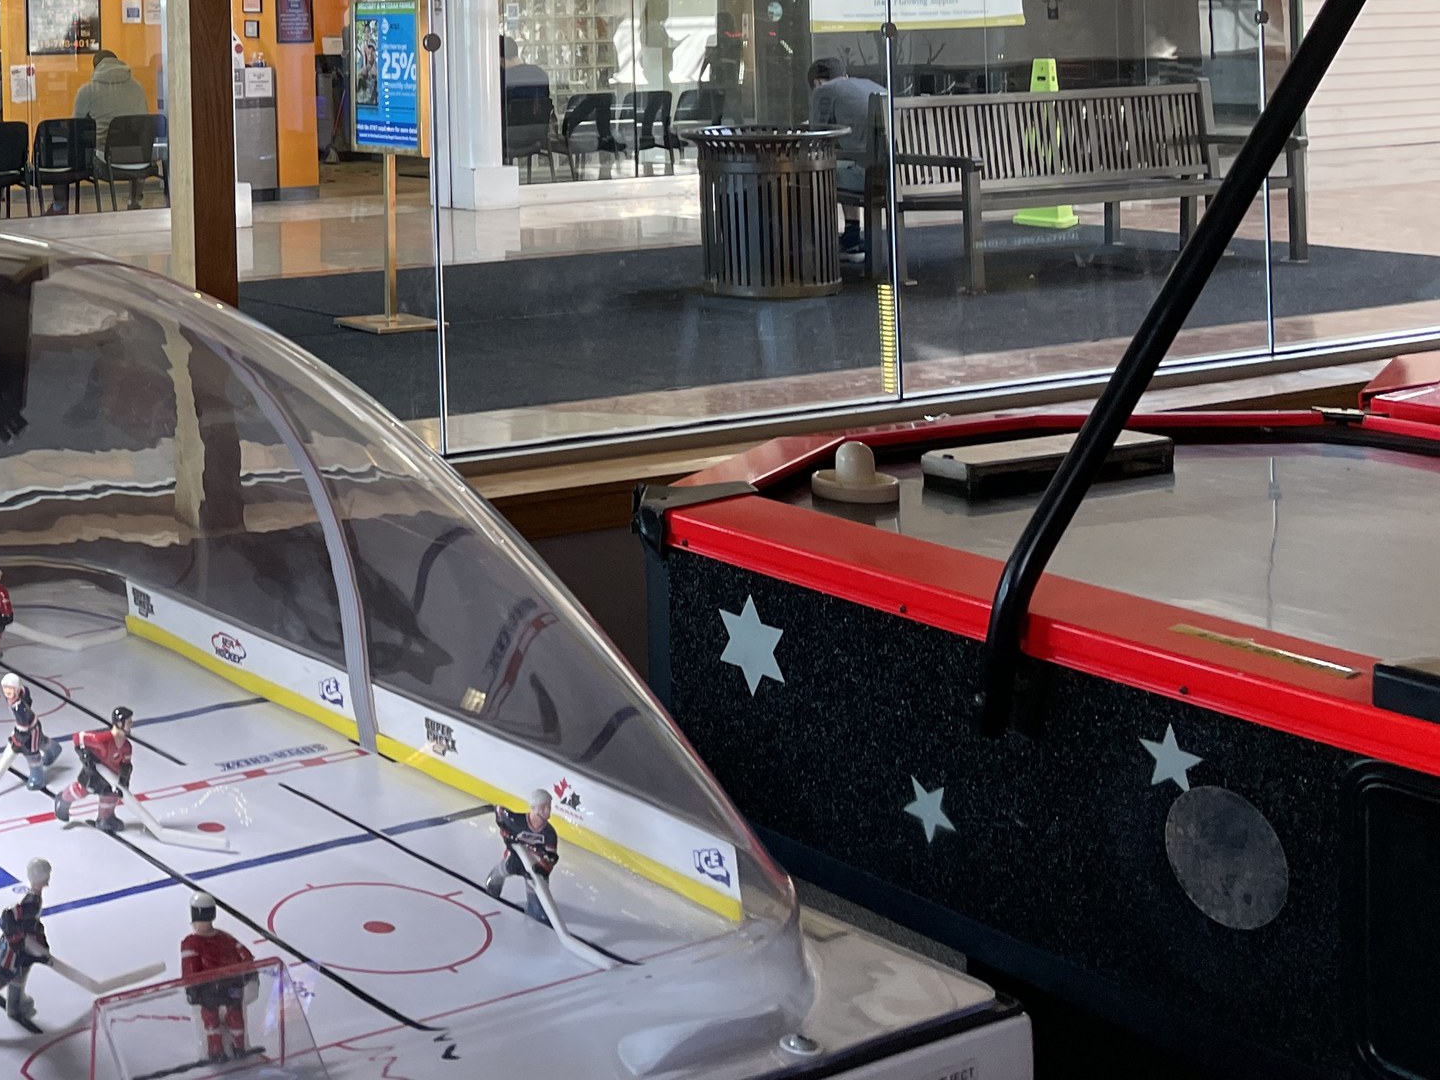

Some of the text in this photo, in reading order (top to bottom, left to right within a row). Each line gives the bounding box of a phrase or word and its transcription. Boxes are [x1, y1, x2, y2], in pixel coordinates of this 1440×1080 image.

[381, 51, 417, 80] 25%
[318, 677, 344, 706] ICE
[425, 717, 454, 737] SUPER
[693, 848, 730, 887] ICE
